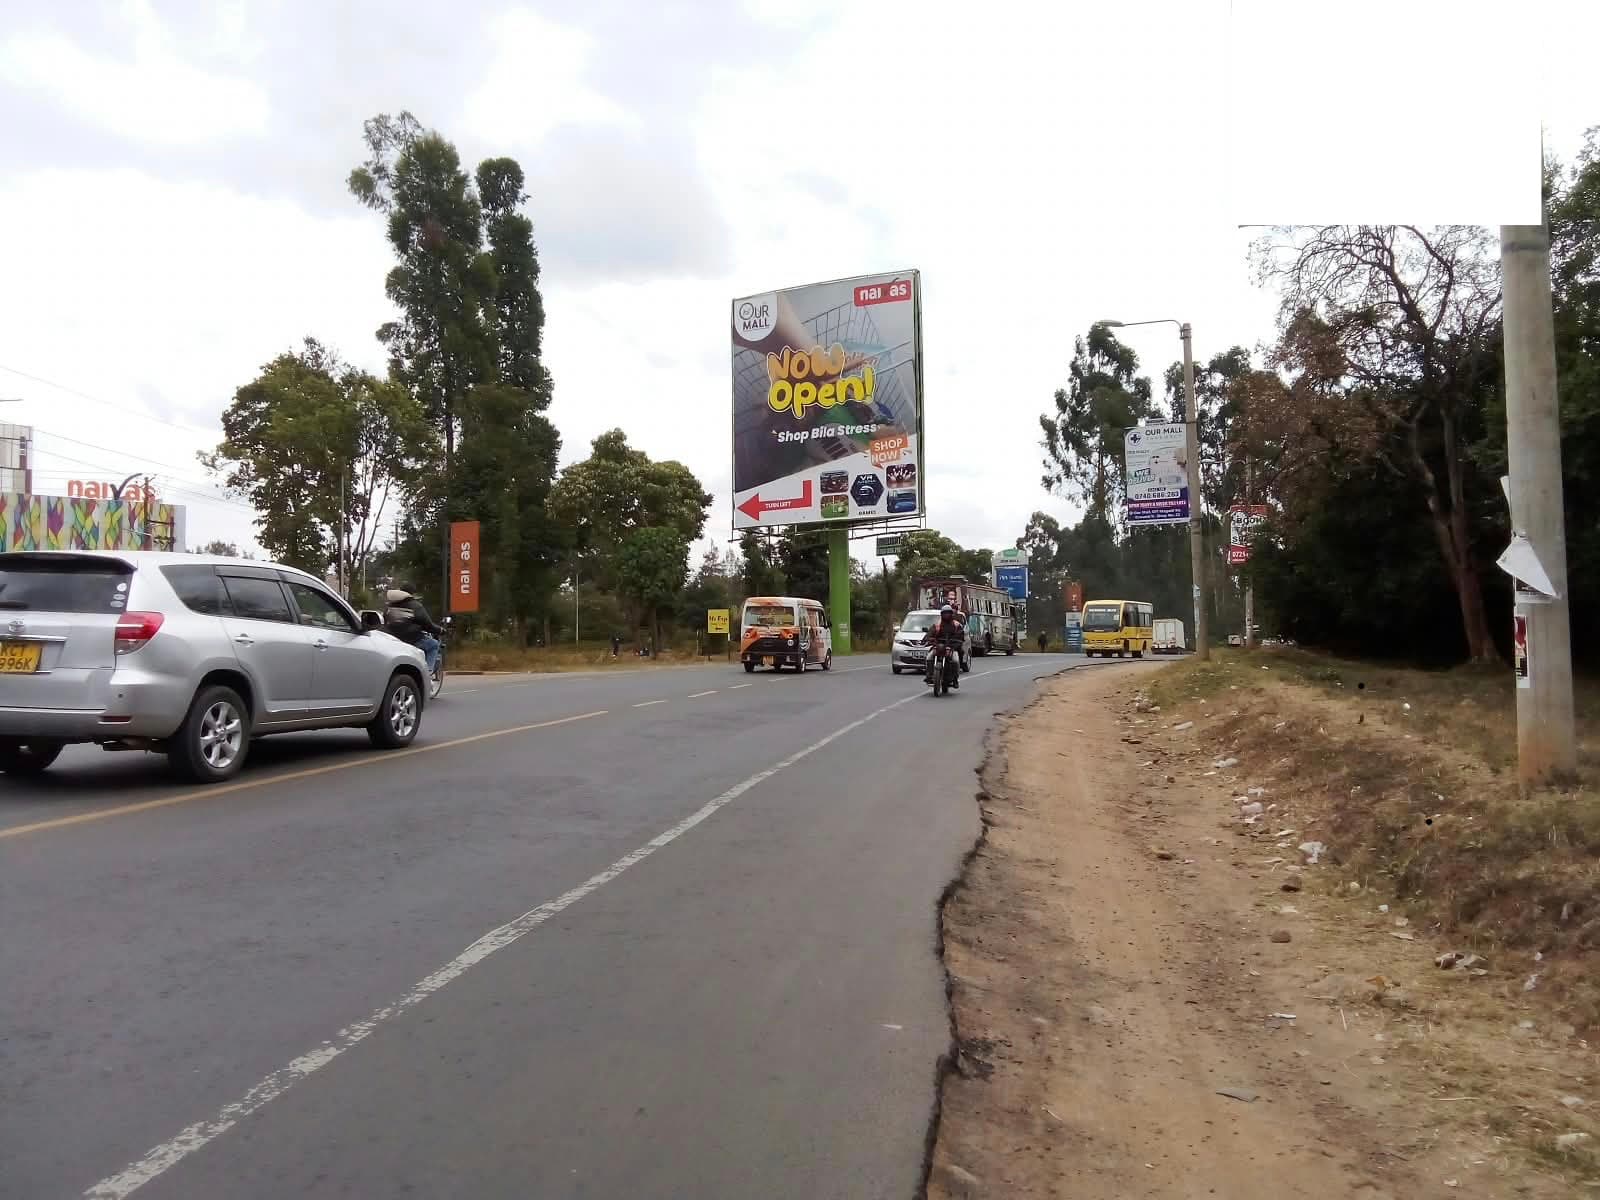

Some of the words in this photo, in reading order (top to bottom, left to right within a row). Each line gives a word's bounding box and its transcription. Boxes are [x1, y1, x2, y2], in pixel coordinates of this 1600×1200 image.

[739, 302, 770, 320] OUR
[743, 318, 769, 331] MALL
[769, 344, 843, 379] NOW
[769, 368, 875, 417] Open!
[777, 430, 809, 443] Shop
[811, 427, 835, 440] Bila
[1145, 428, 1161, 436] OUR
[1163, 426, 1182, 434] MALL
[874, 438, 903, 451] SHOP
[461, 542, 471, 594] naias
